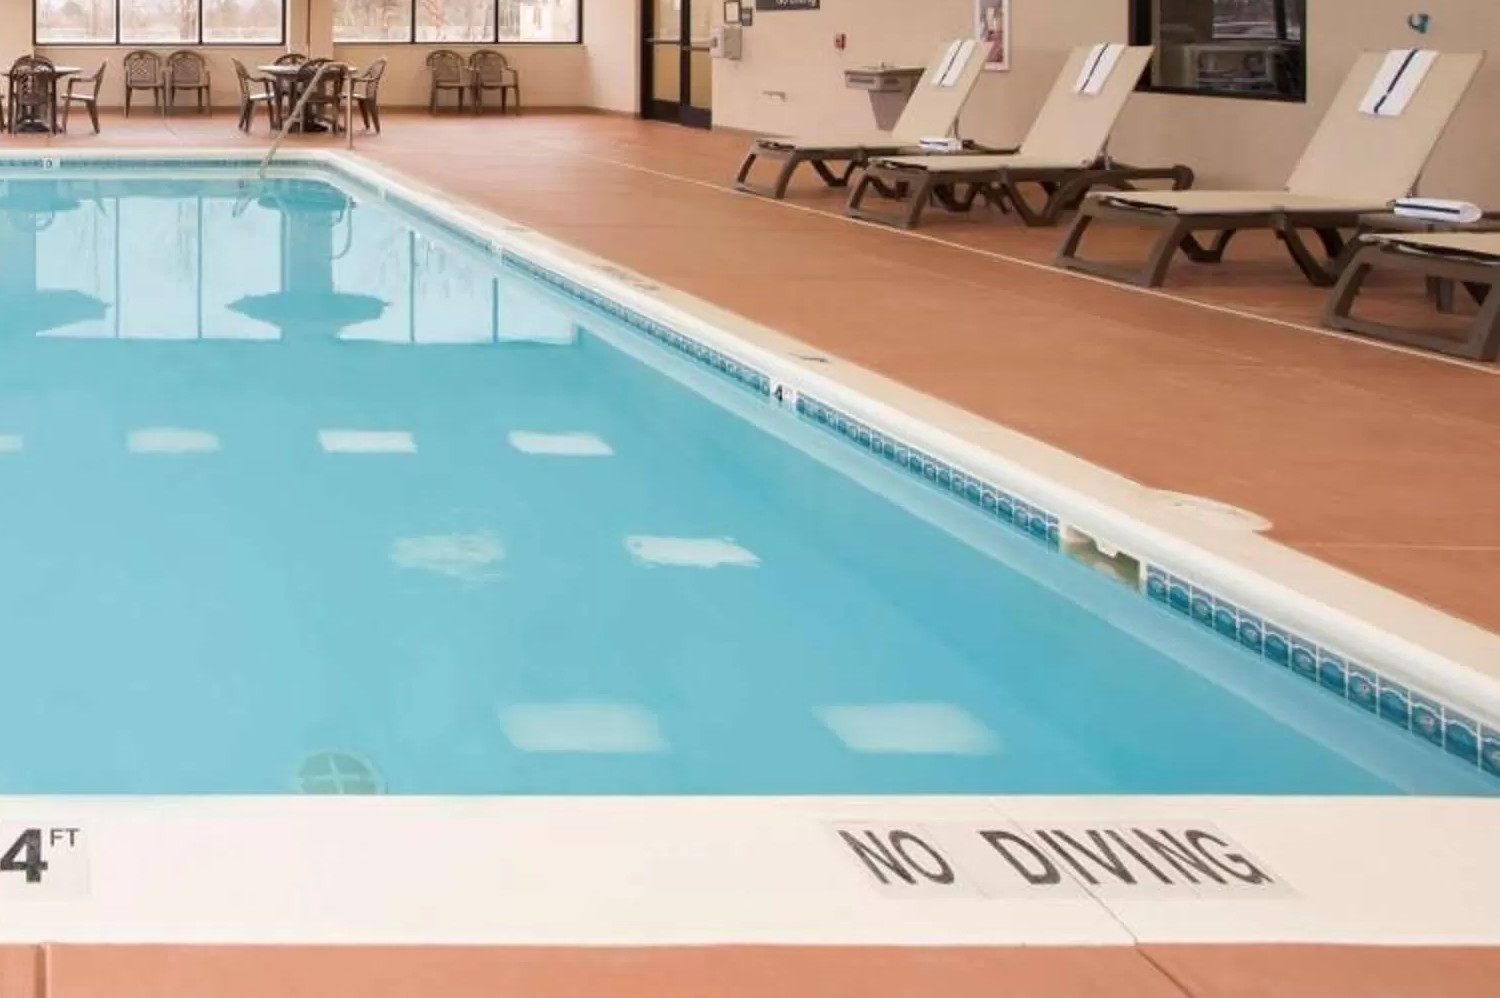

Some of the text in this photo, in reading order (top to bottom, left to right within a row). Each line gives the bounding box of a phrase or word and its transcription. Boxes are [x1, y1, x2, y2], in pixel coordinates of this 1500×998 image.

[0, 828, 80, 883] 4 FT
[836, 828, 1276, 885] NO DIVING
